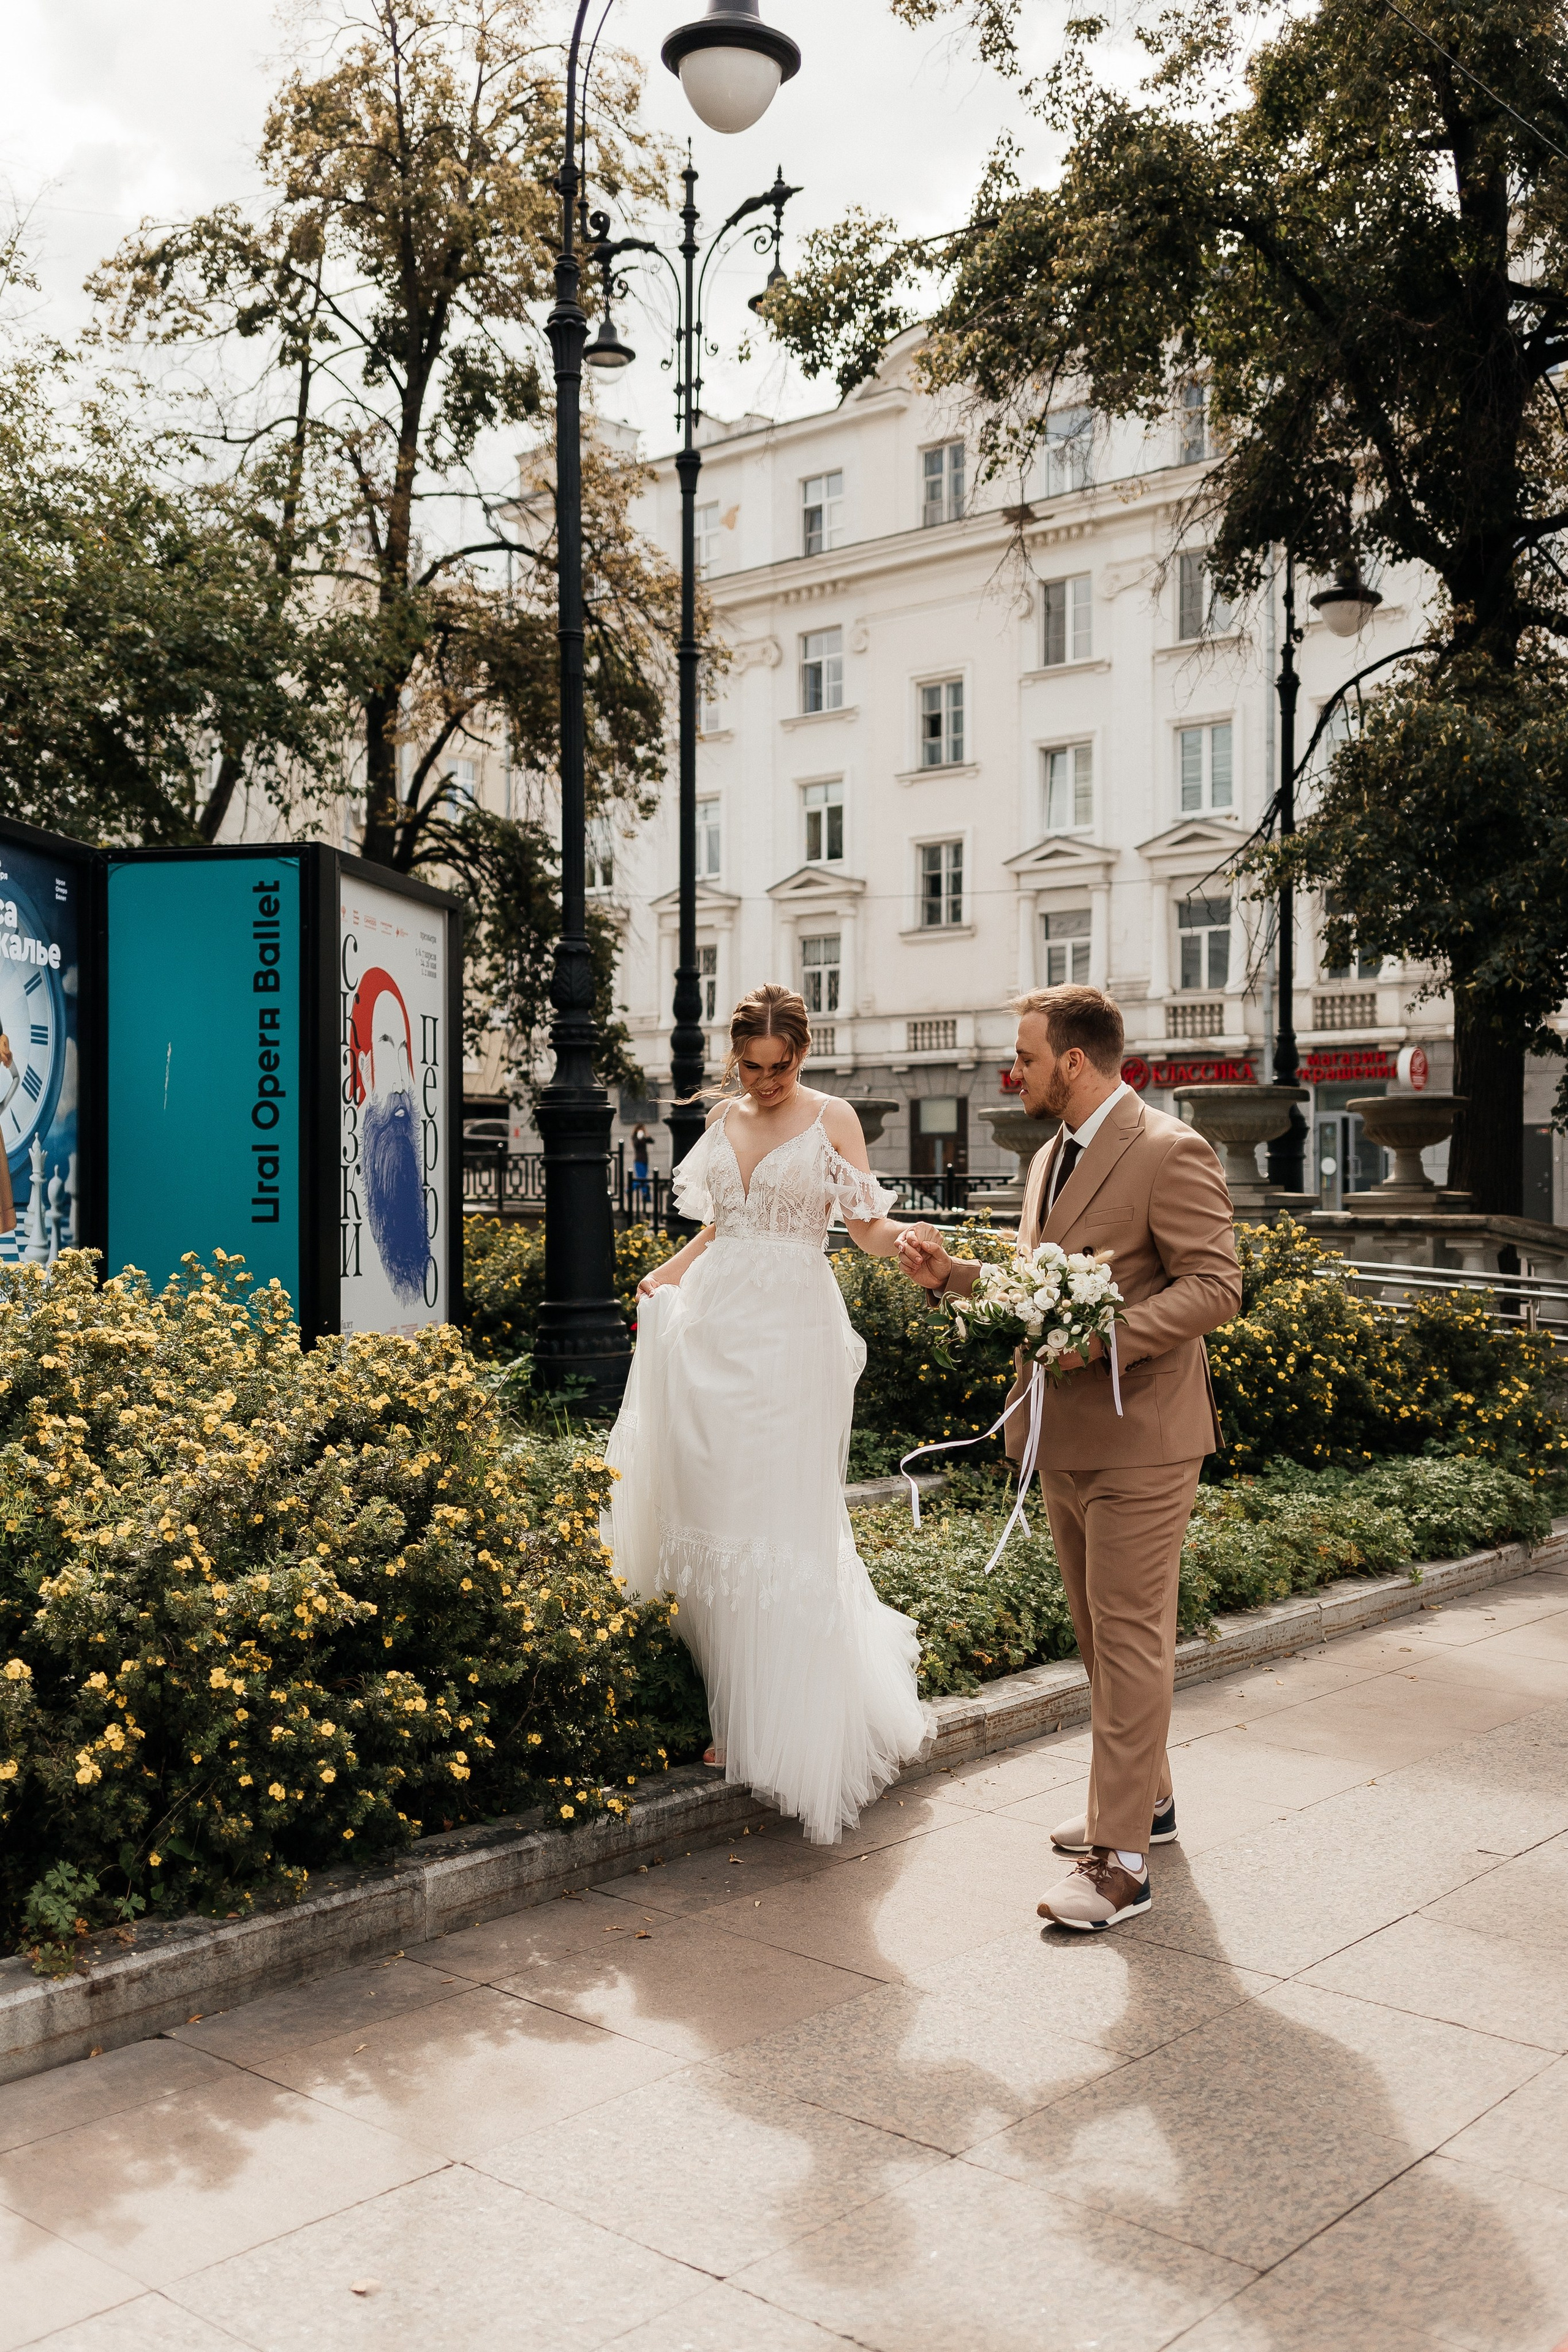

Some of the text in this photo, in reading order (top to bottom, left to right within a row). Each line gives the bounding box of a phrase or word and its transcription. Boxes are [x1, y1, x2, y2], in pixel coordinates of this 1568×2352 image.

[252, 880, 280, 993] Ballet
[1152, 1061, 1254, 1082] КЛАССИКА
[1306, 1051, 1387, 1066] магазин
[251, 1144, 279, 1223] Ural
